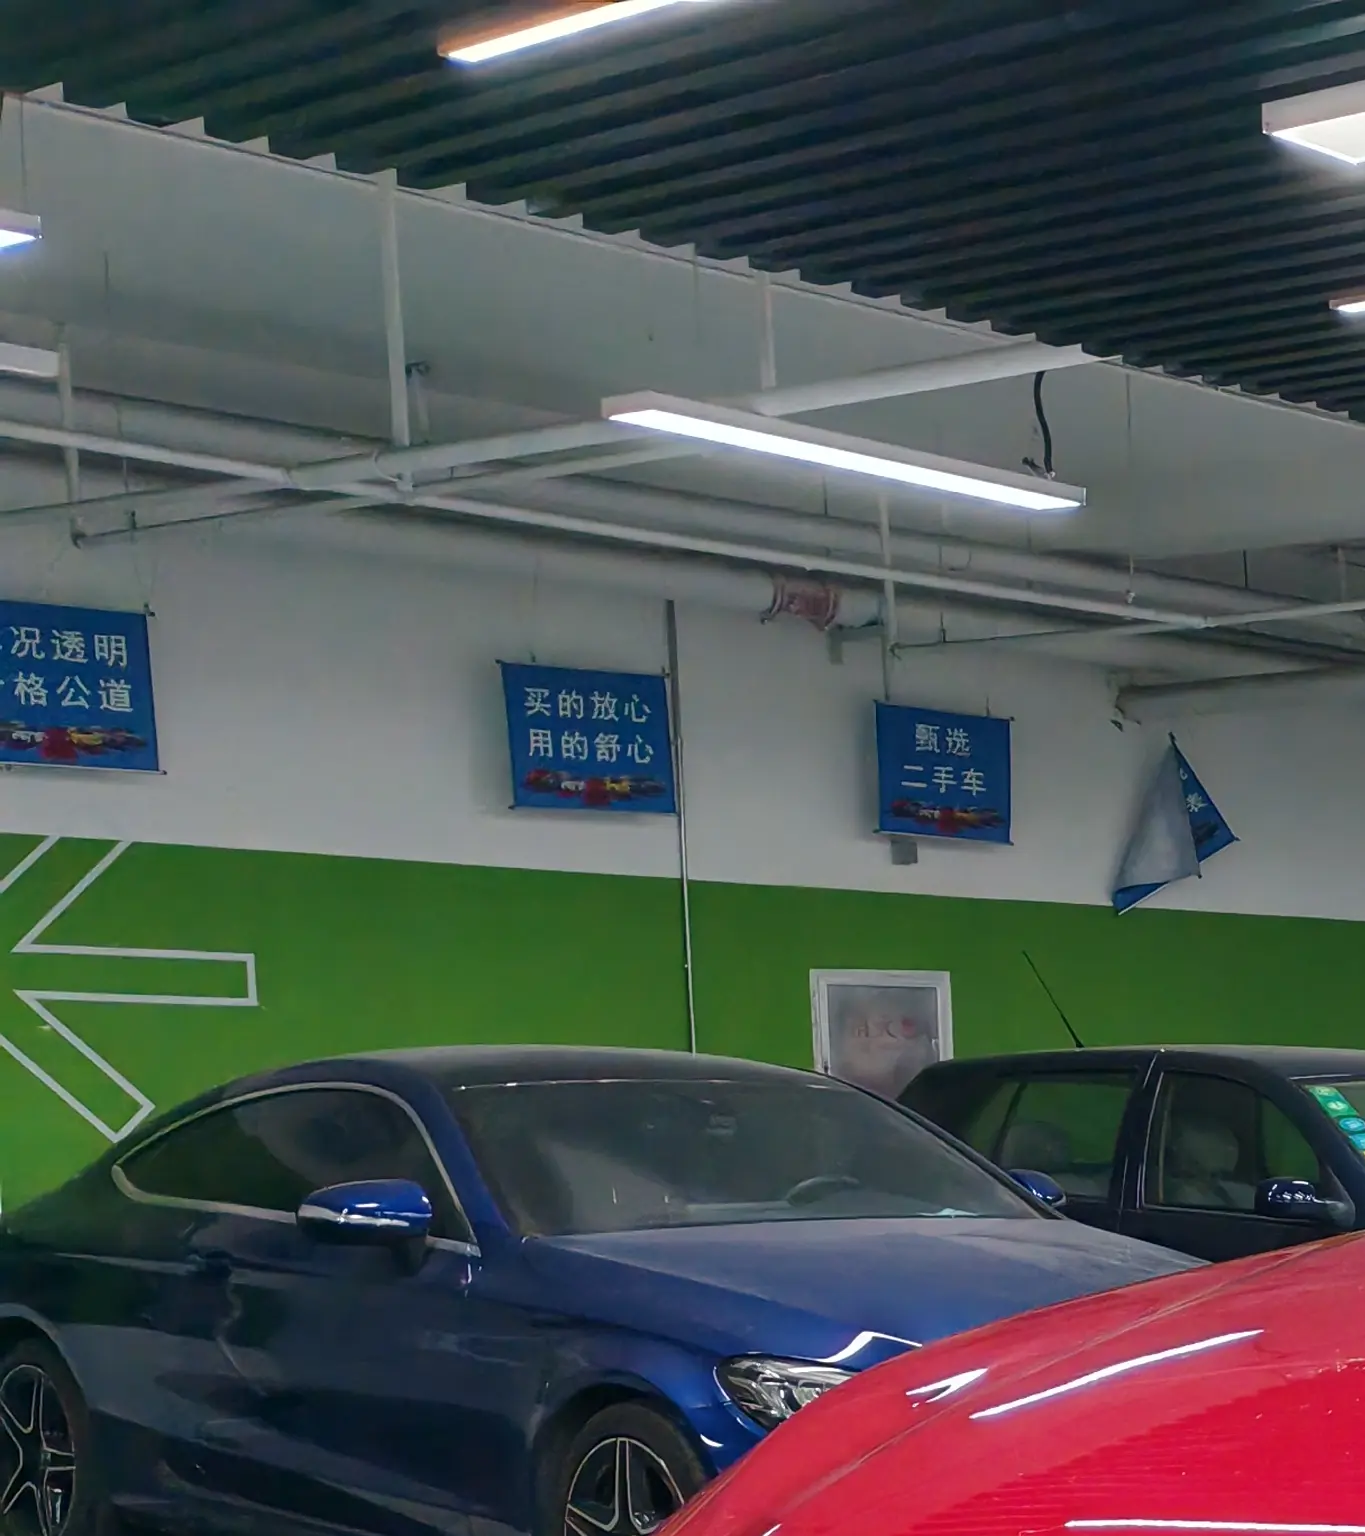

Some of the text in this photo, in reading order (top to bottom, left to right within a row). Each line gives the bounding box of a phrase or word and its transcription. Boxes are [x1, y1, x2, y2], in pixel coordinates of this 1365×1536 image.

[0, 625, 128, 667] 况透明
[0, 671, 134, 713] 格公道
[523, 687, 652, 723] 买的放心
[528, 729, 655, 764] 用的舒心
[914, 723, 972, 757] 甄选
[900, 765, 987, 796] 二手车
